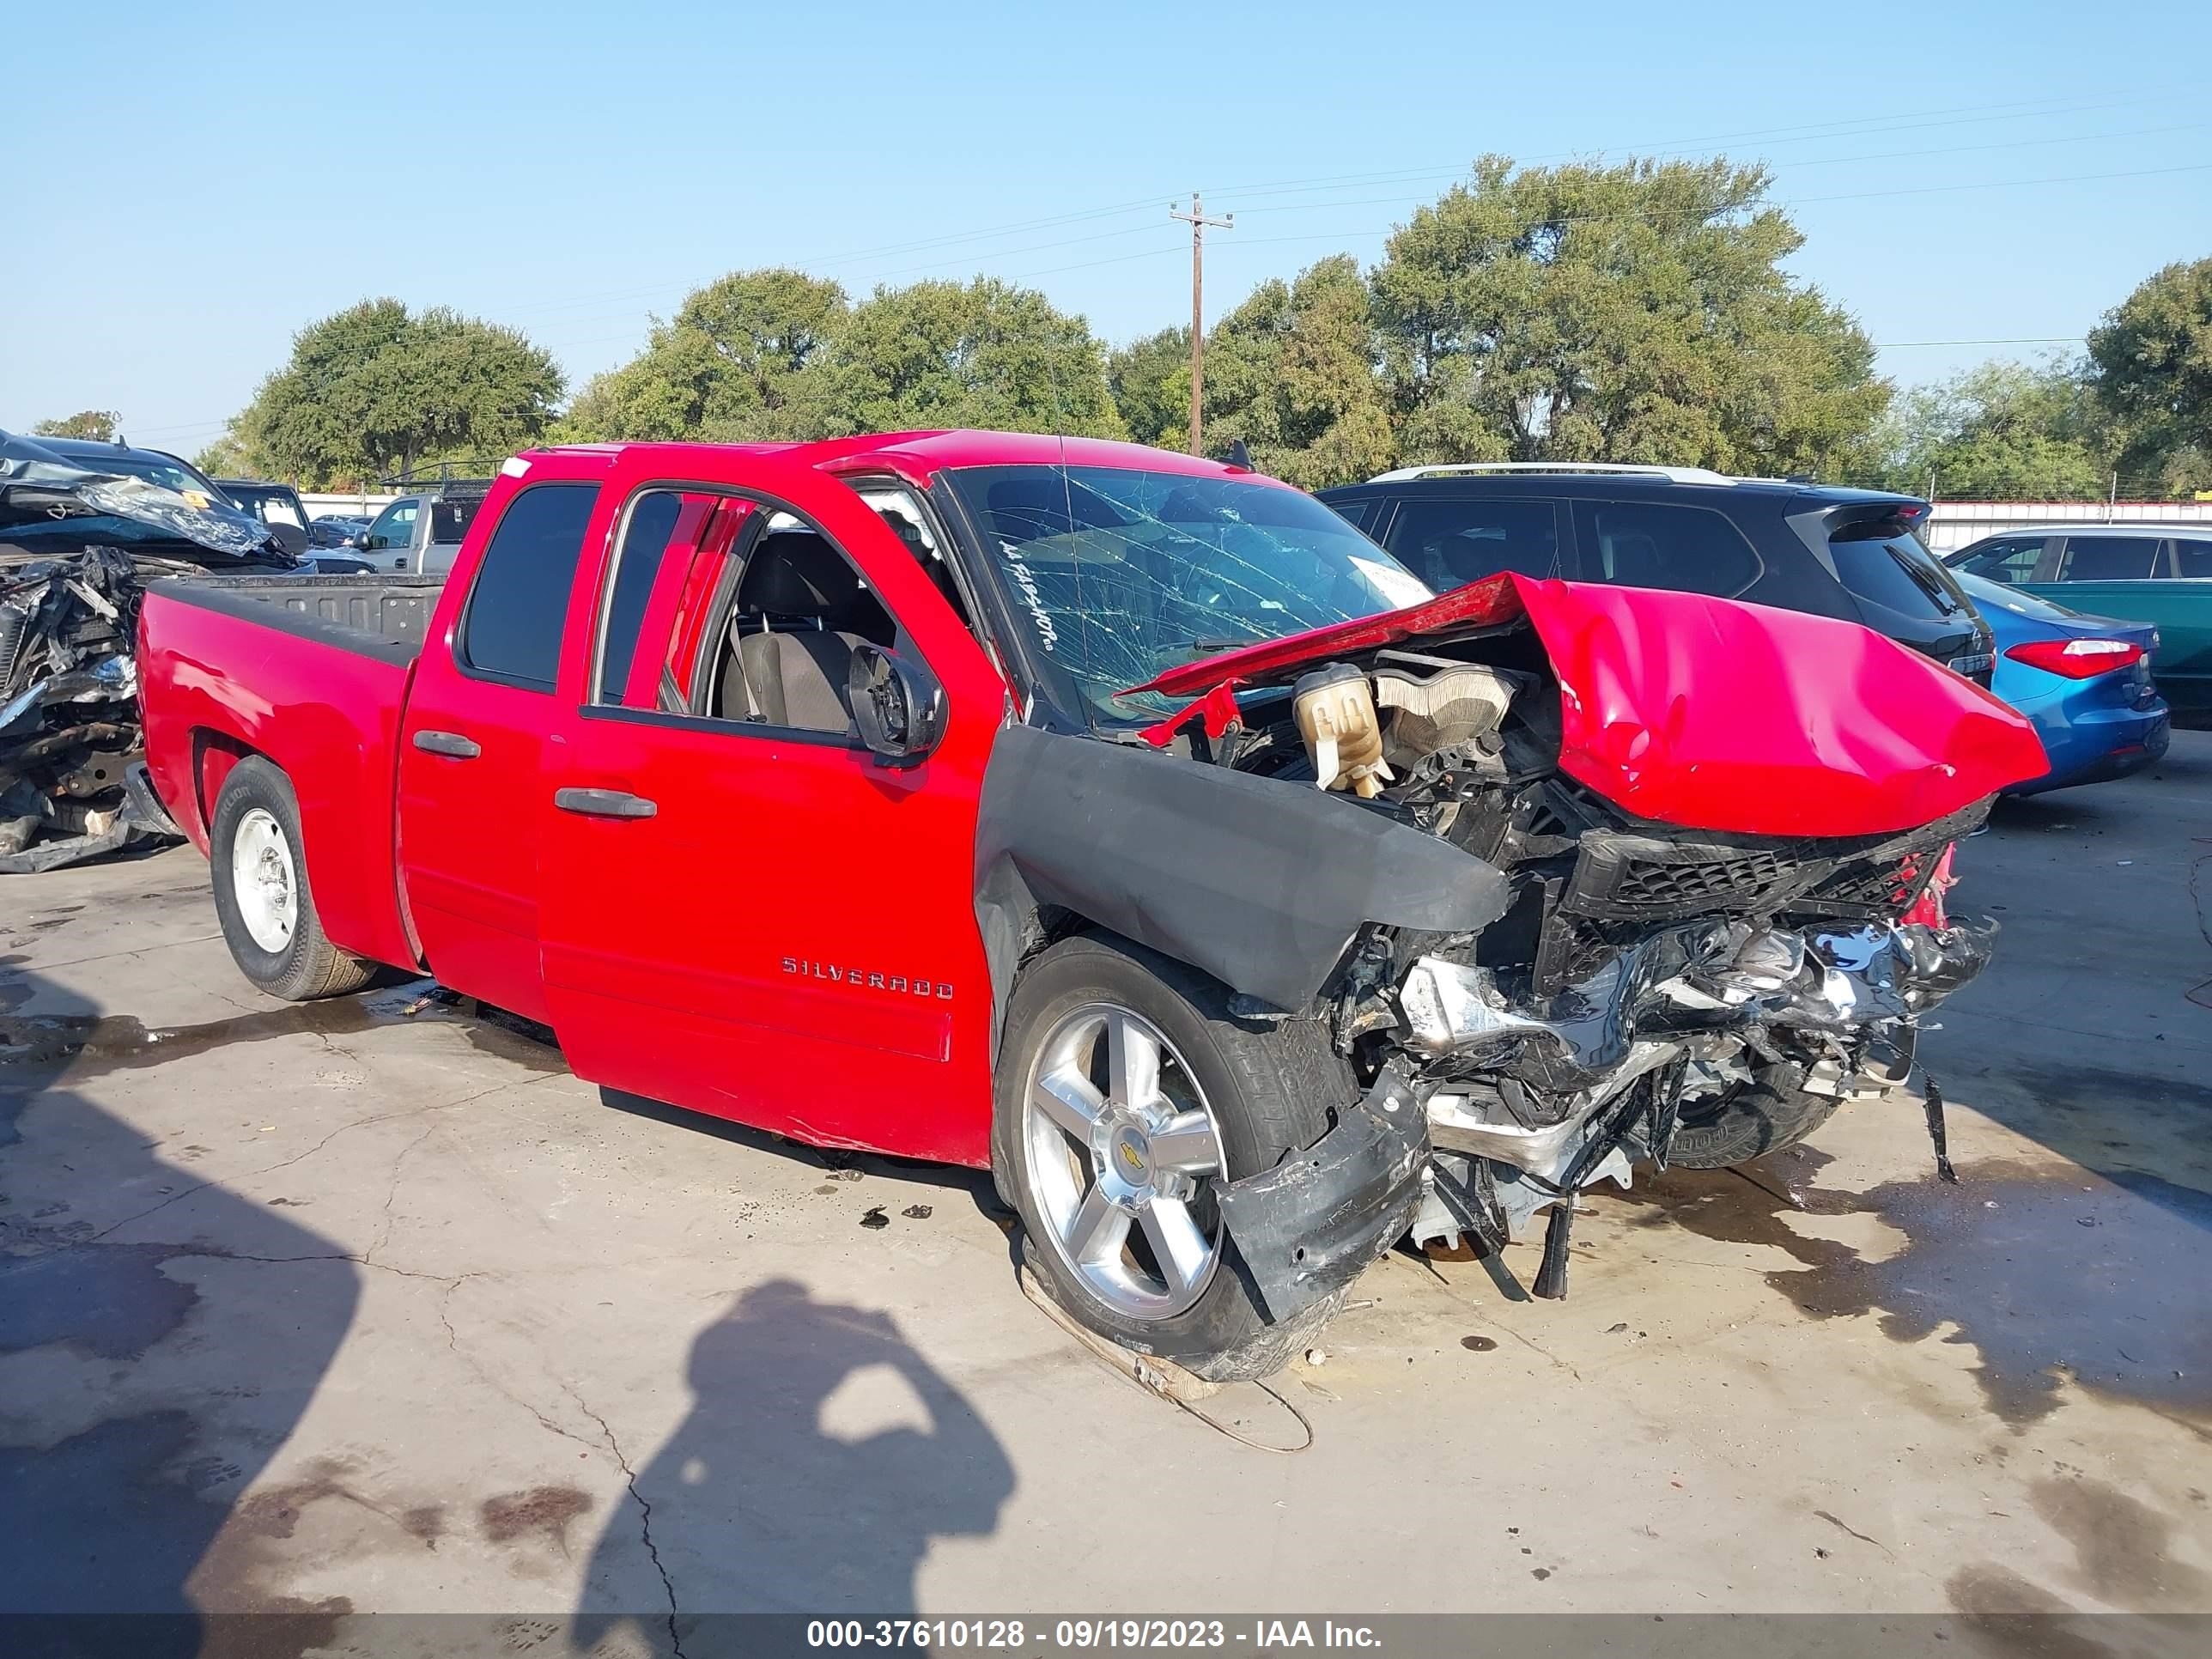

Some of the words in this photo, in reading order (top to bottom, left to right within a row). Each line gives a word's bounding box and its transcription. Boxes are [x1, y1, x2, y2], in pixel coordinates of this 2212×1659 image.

[999, 540, 1023, 560] AA
[1010, 563, 1058, 641] FABSHOP
[782, 957, 953, 1000] SILVERADO
